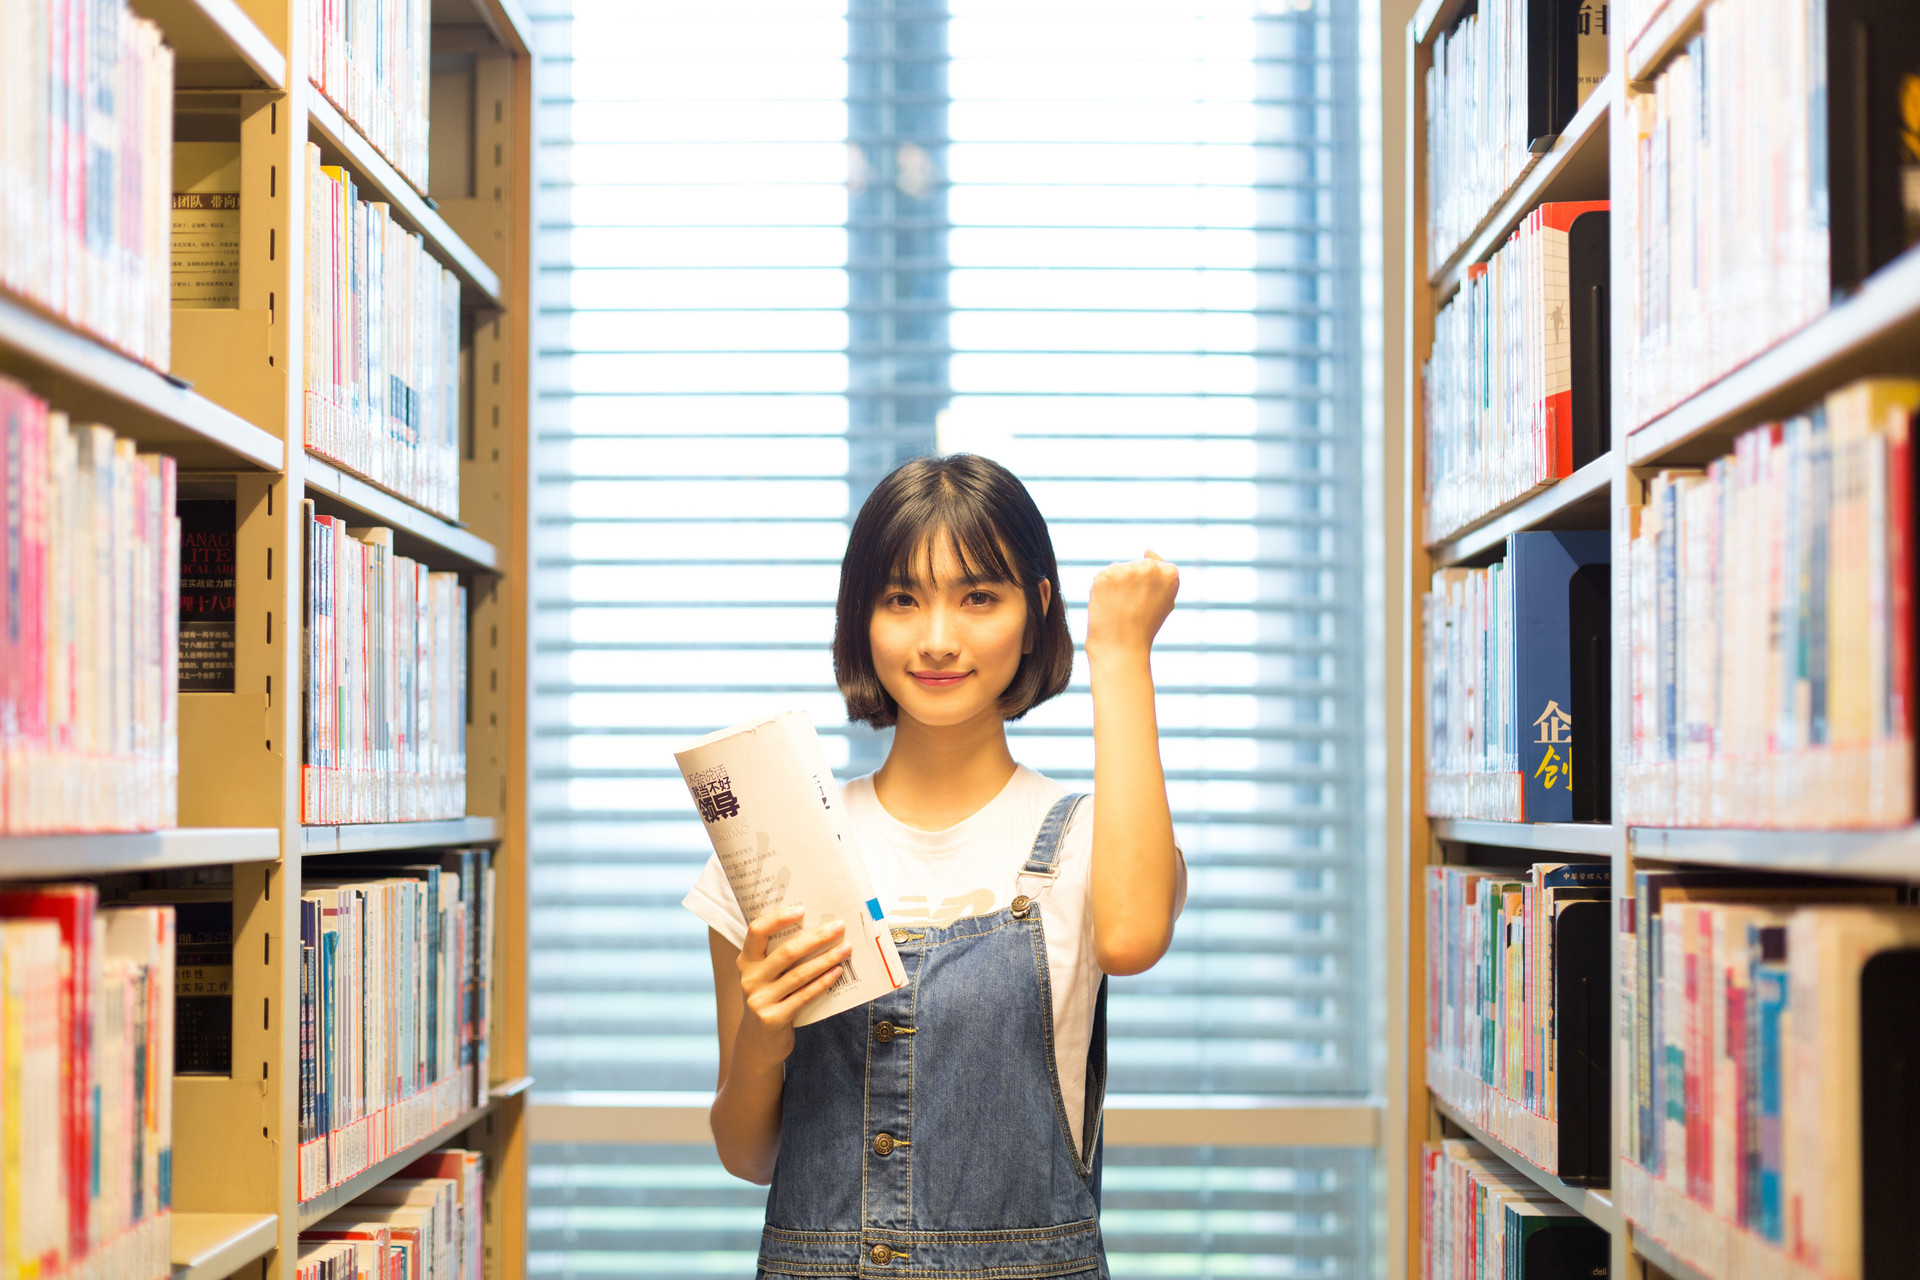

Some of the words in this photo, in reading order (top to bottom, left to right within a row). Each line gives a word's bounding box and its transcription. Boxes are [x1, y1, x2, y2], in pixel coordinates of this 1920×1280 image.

[191, 548, 236, 562] ITE
[686, 764, 728, 785] 不会说话
[692, 776, 731, 799] 就当不好
[698, 790, 740, 824] 领导
[1592, 1267, 1607, 1276] deli
